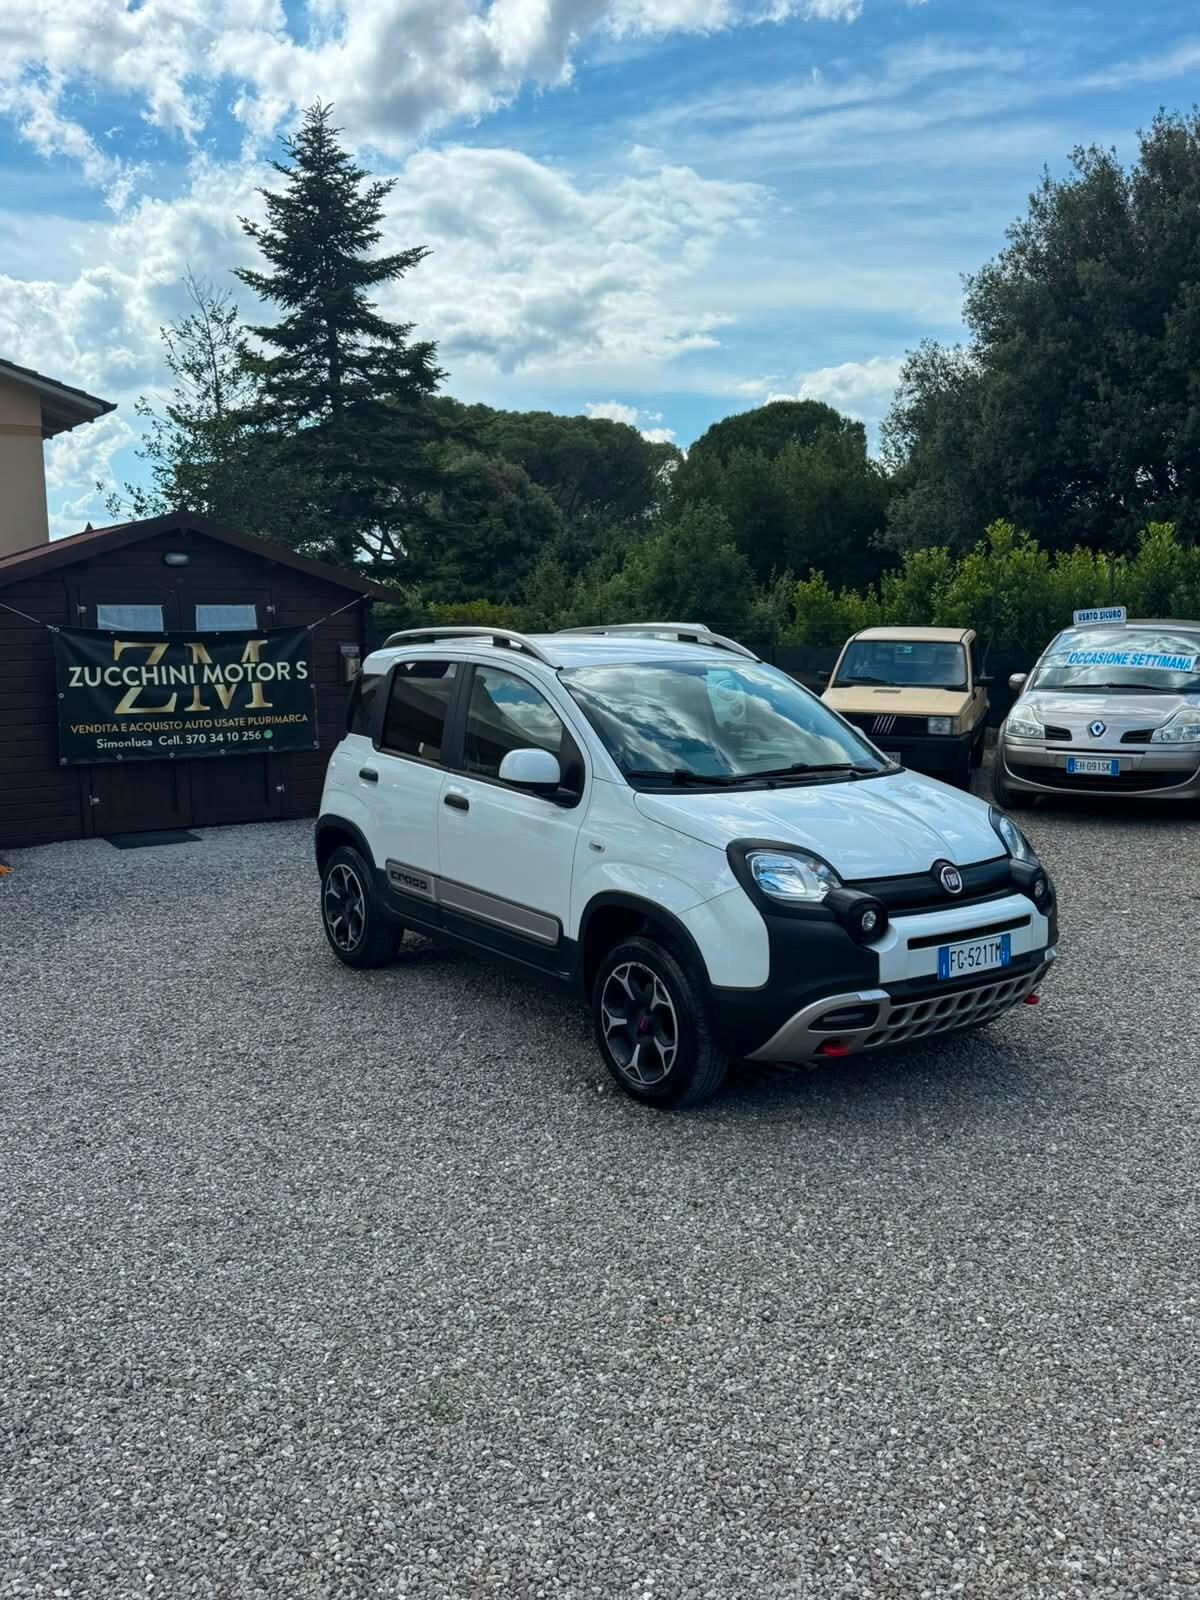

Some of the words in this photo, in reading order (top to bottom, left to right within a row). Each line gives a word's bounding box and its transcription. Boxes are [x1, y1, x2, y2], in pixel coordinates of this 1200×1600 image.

[1078, 611, 1098, 621] USATO
[1099, 609, 1122, 619] SICURO
[1068, 651, 1129, 665] OCCASIONE
[1129, 652, 1192, 670] SETTIMANA
[68, 665, 196, 687] ZUCCHINI
[203, 661, 308, 684] MOTORS
[113, 639, 273, 714] ZM
[70, 722, 119, 735] VENDITA
[121, 722, 127, 732] E
[130, 720, 183, 733] ACQUISTO
[184, 719, 213, 730] AUTO
[214, 717, 245, 728] USATE
[247, 713, 309, 727] PLURIMARCA
[96, 737, 154, 749] Simonluca
[158, 734, 184, 746] Cell.
[185, 733, 207, 744] 370
[209, 732, 224, 743] 34
[226, 731, 240, 742] 10
[242, 730, 262, 741] 256
